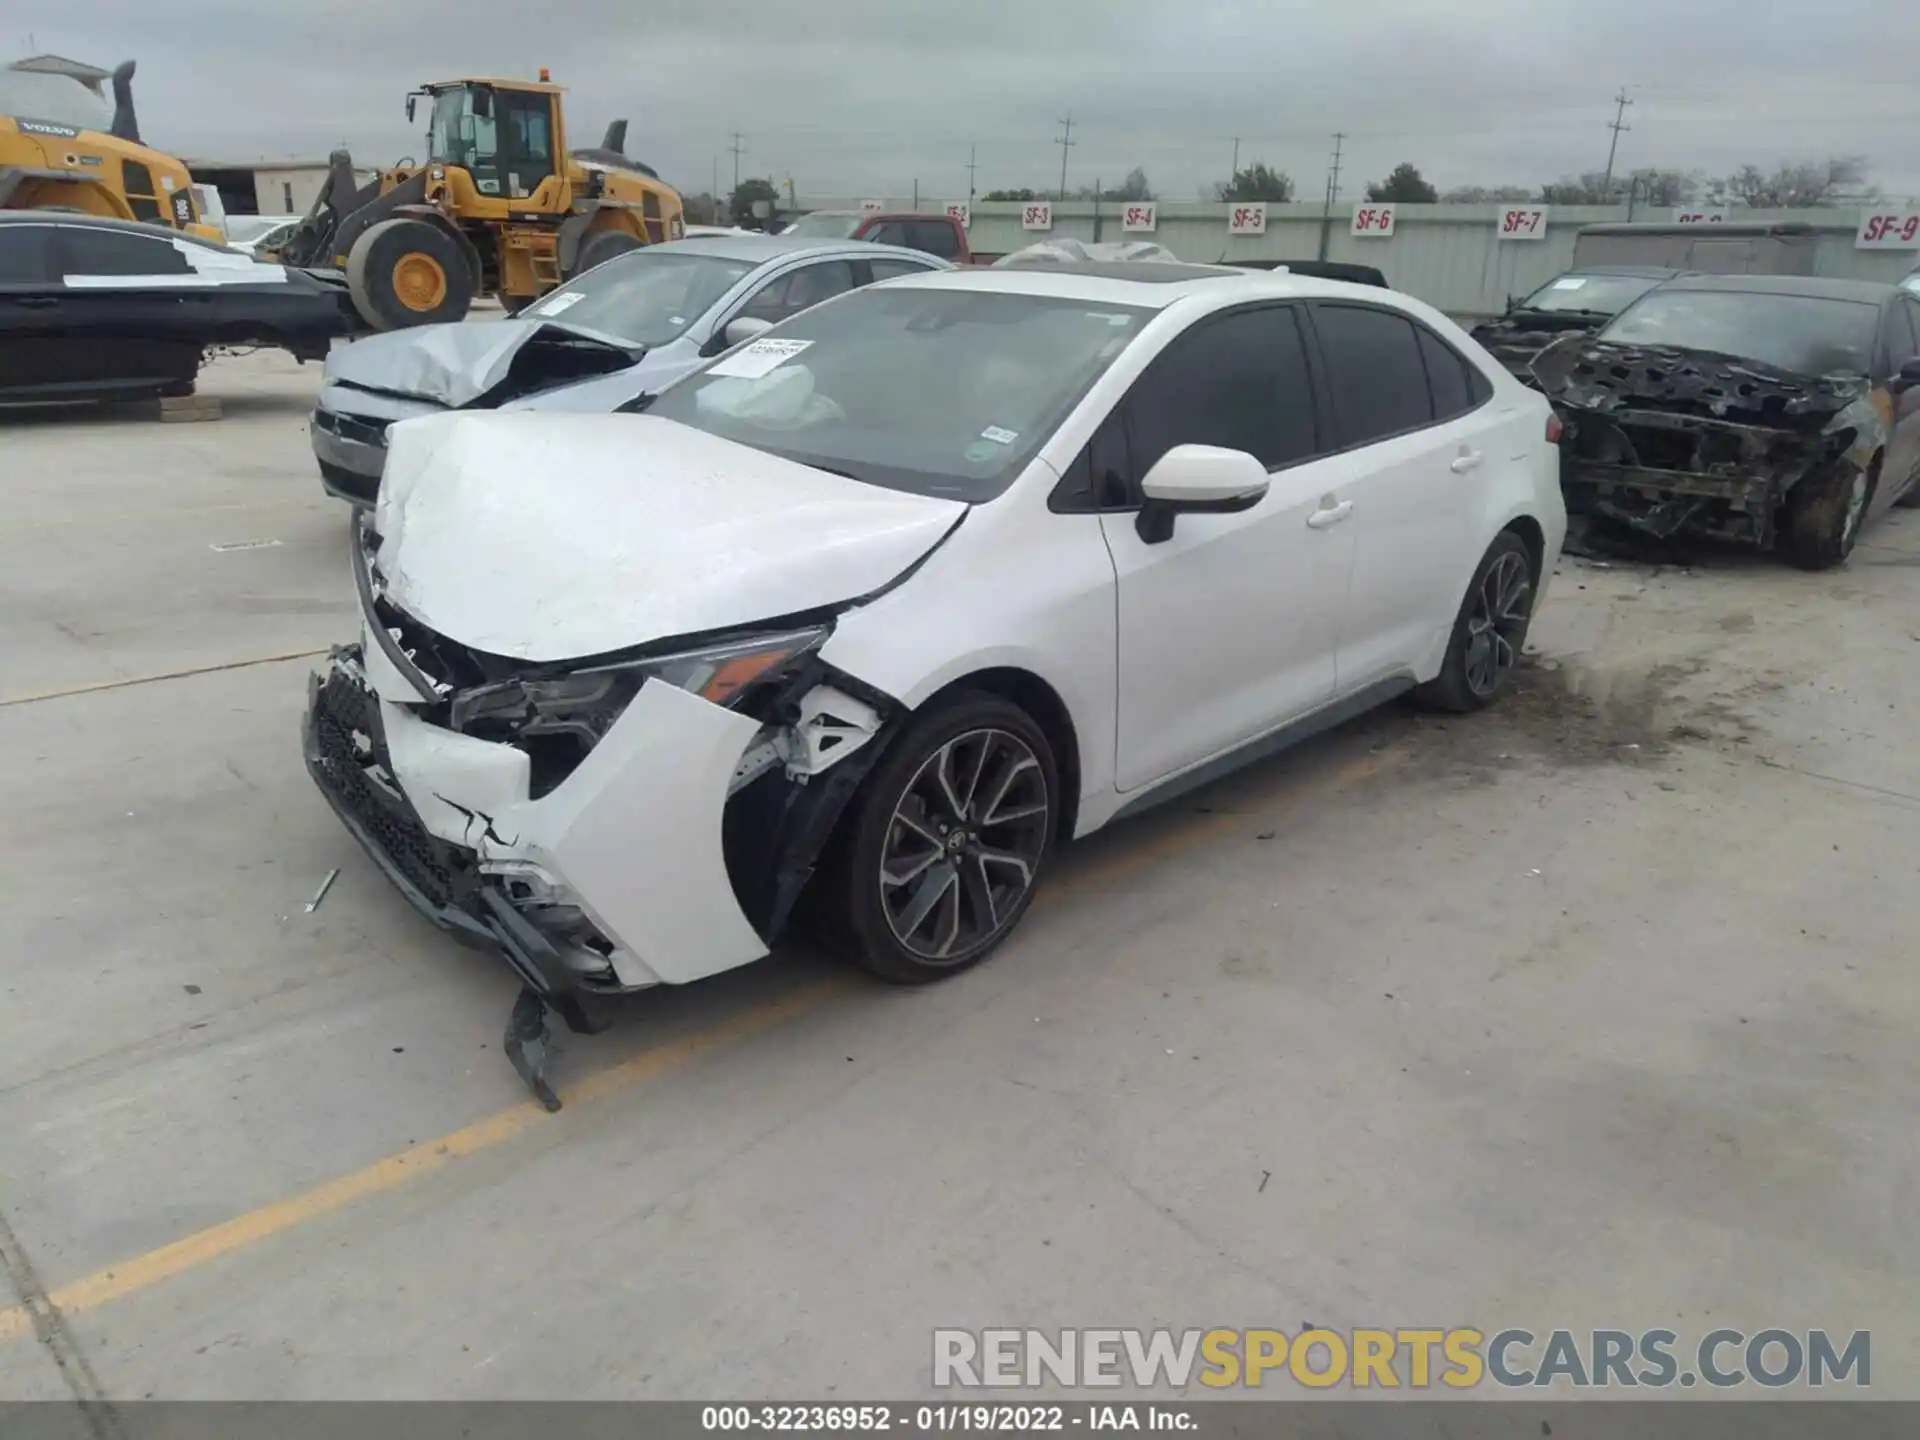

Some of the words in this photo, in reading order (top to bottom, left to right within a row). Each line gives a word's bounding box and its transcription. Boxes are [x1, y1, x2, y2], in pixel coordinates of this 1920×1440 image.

[20, 121, 76, 137] VOLVO
[1024, 206, 1049, 224] SF-3
[1126, 207, 1152, 226] SF-4
[1232, 208, 1263, 229] SF-5
[1356, 209, 1392, 230] SF-6
[1503, 210, 1542, 233] SF-7
[1863, 215, 1919, 242] SF-9
